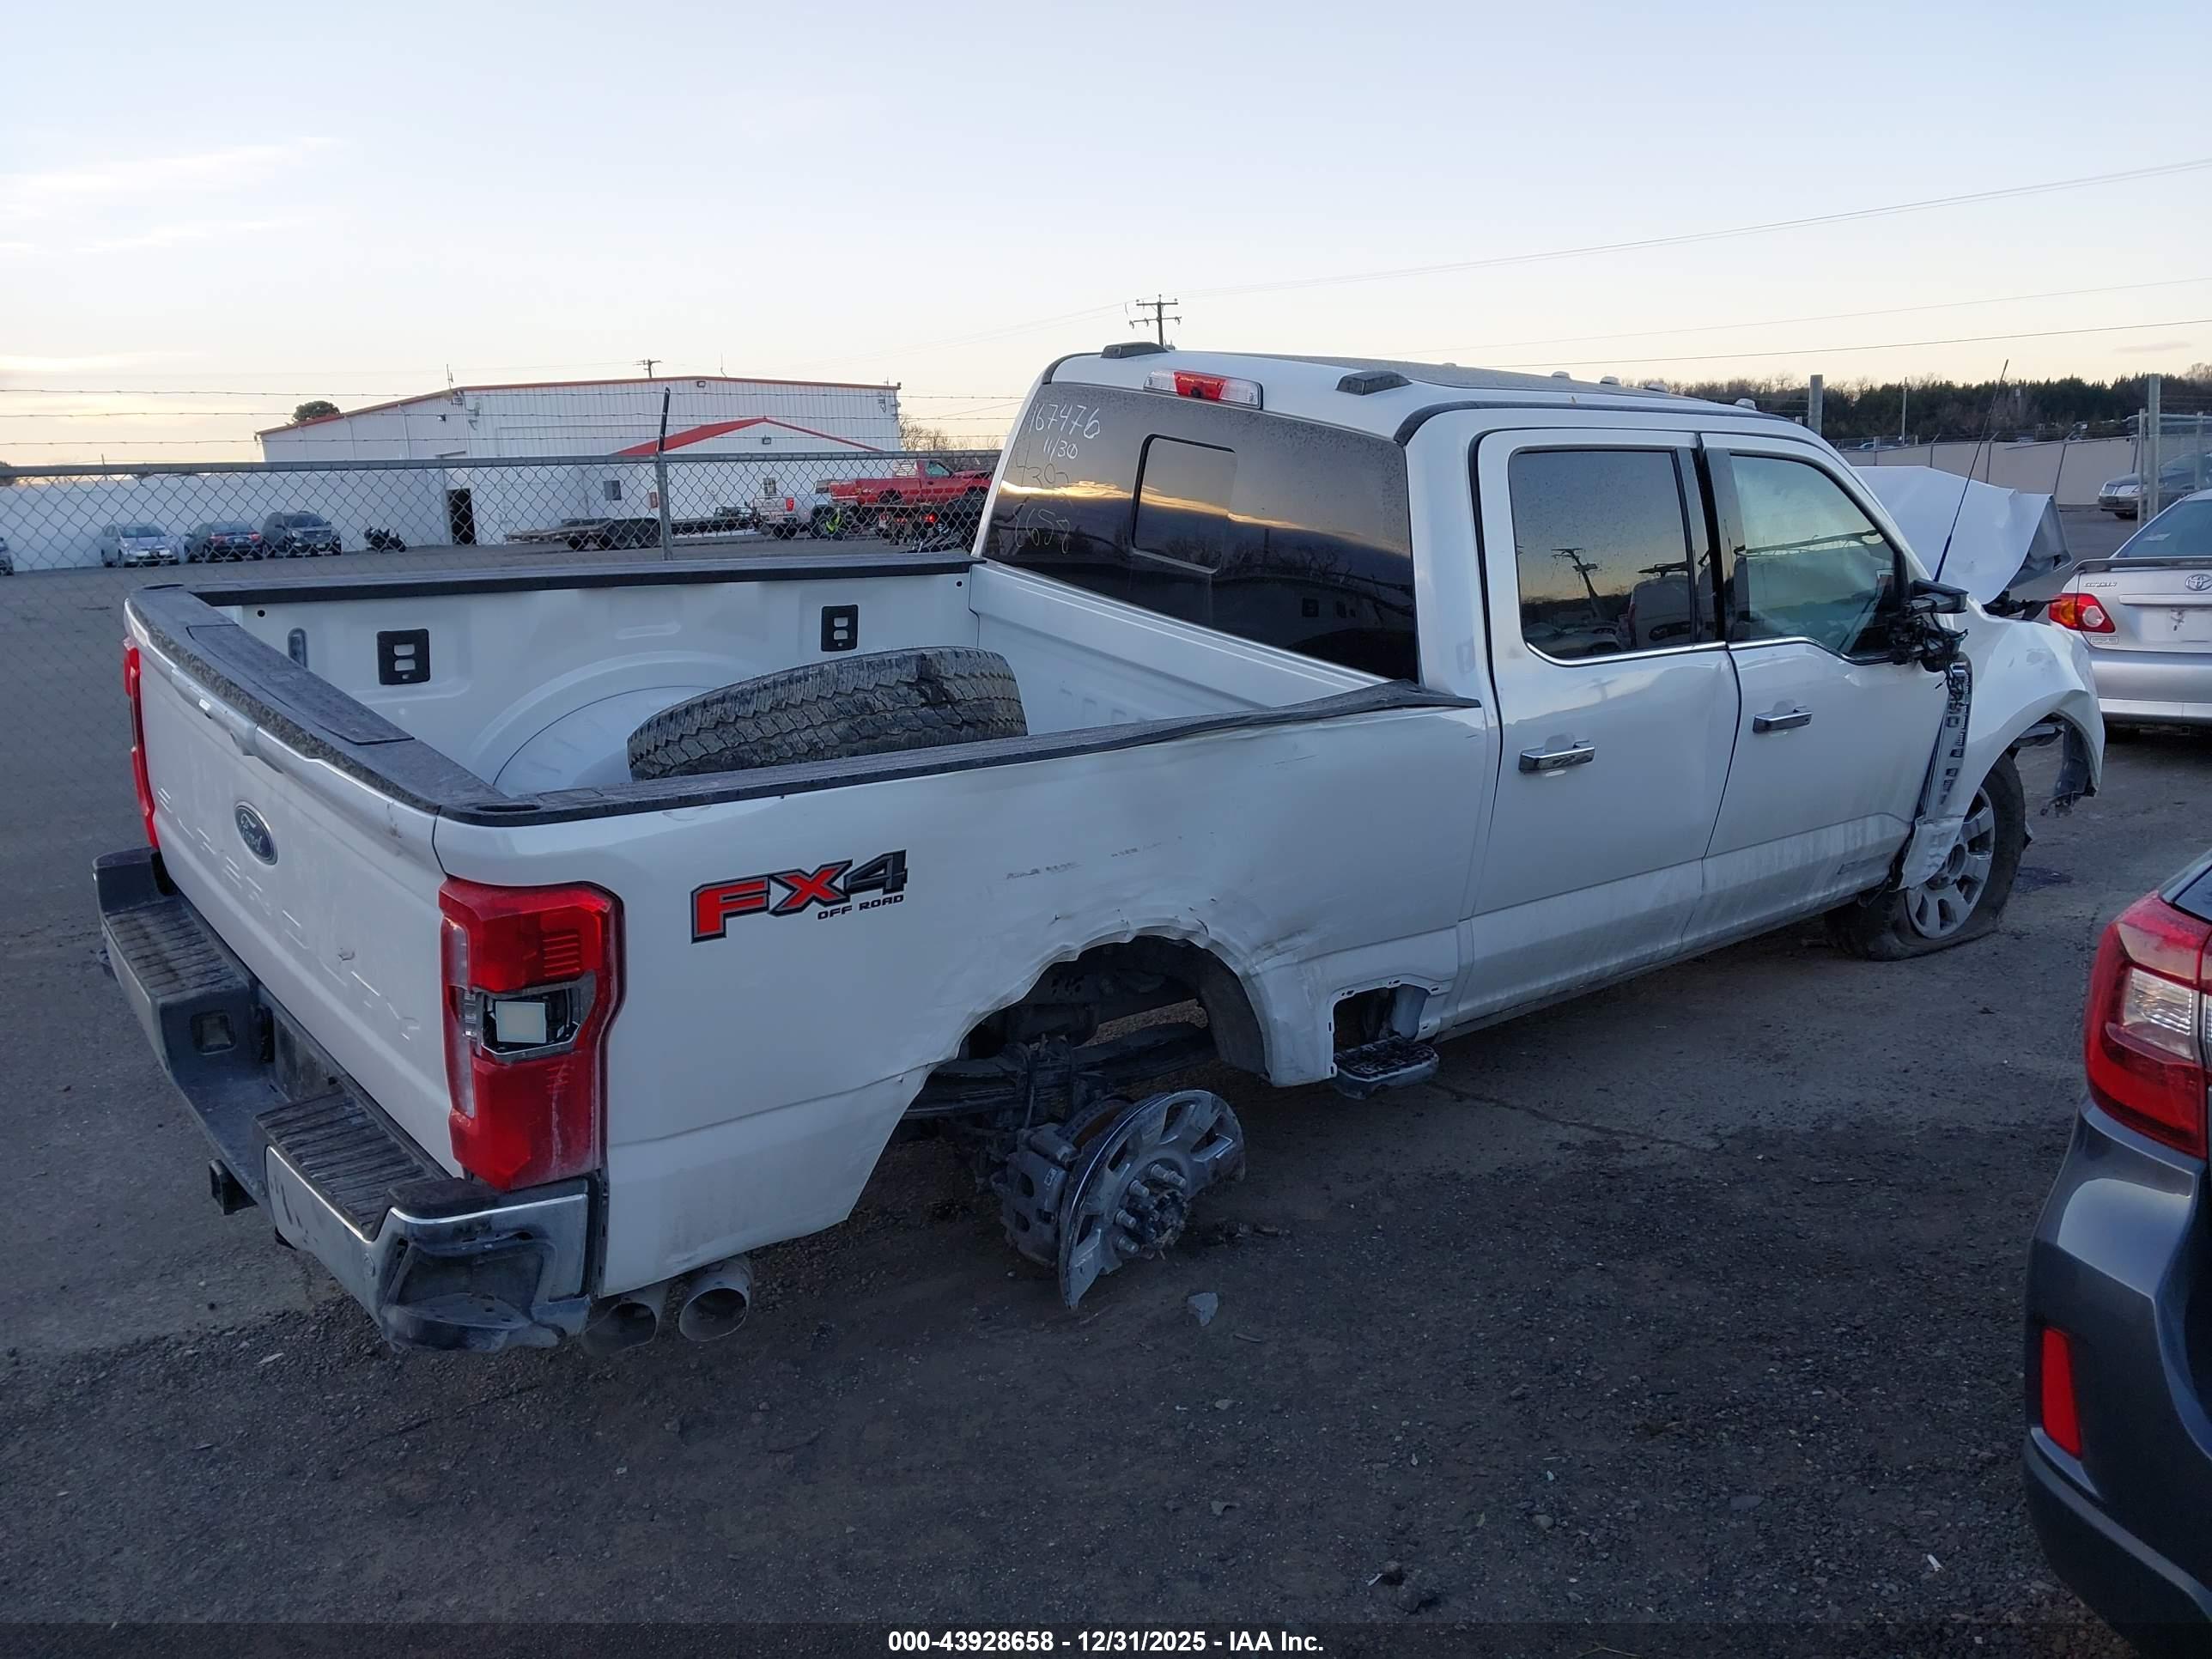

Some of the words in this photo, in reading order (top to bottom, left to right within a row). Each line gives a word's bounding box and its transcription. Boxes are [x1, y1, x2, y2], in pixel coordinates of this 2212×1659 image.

[1030, 403, 1101, 440] 167476
[1042, 435, 1079, 462] 11/30
[690, 849, 908, 945] FX4
[817, 904, 853, 921] OFF
[859, 894, 904, 911] ROAD
